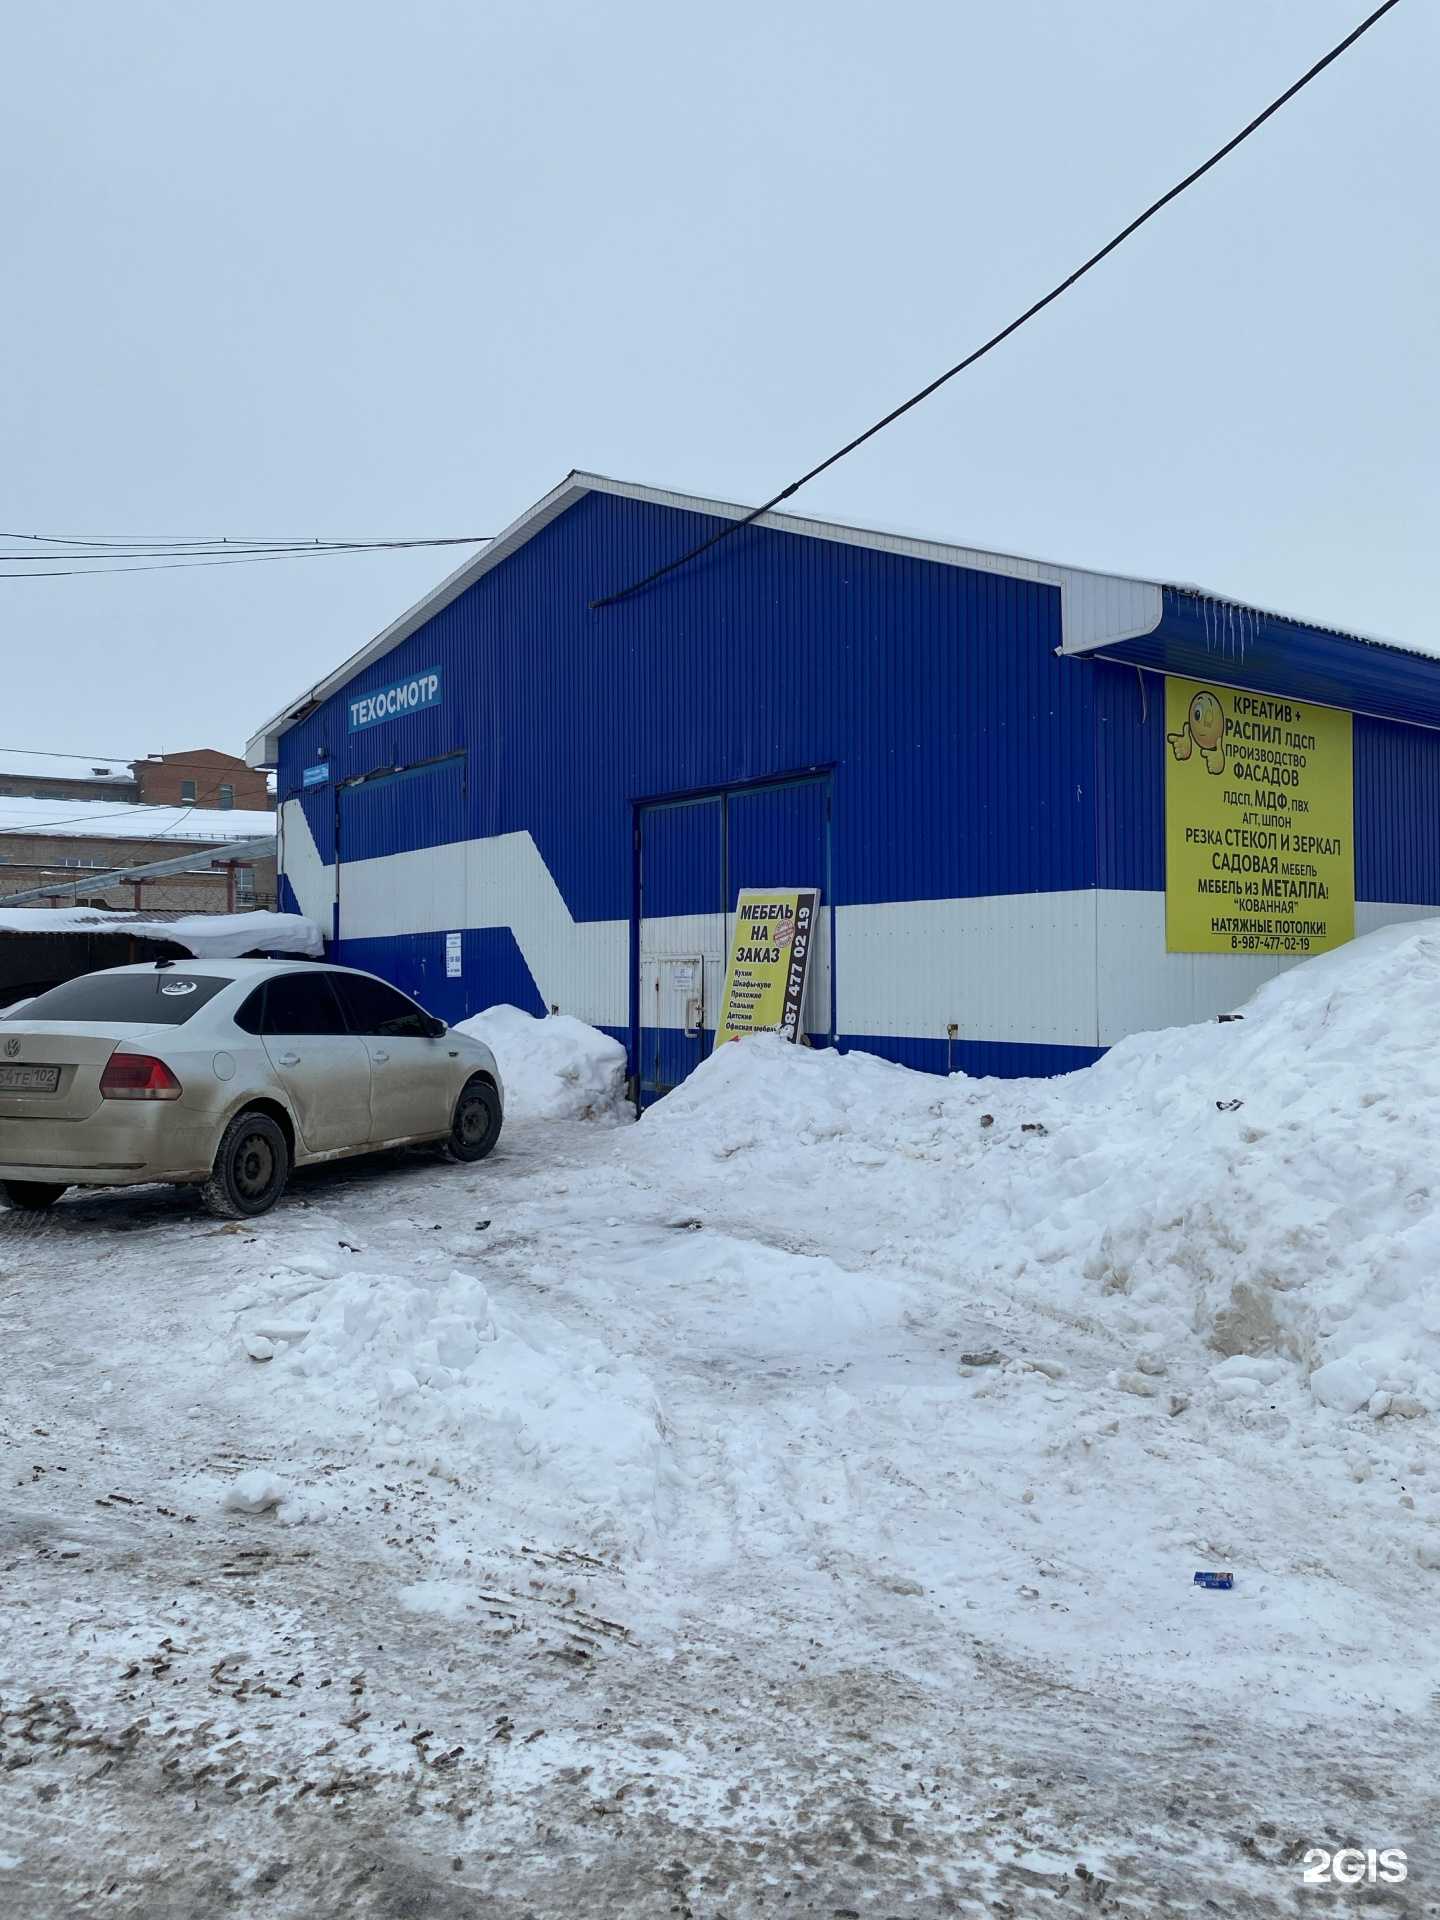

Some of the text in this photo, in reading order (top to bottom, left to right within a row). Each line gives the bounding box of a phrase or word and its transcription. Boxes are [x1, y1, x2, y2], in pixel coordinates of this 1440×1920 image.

[350, 675, 438, 726] ТЕХОСМОТР
[1233, 695, 1292, 723] КРЕАТИВ
[1225, 718, 1315, 750] РАСПИЛ ЛДСП
[1225, 743, 1307, 768] ПРОИЗВОДСТВО
[1233, 762, 1299, 787] ФАСАДОВ
[1291, 799, 1309, 813] ПВХ
[1261, 814, 1292, 829] ШПОН
[1185, 827, 1341, 856] РЕЗКА СТЕКОЛ И ЗЕРКАЛ
[1212, 852, 1318, 877] САДОВАЯ МЕБЕЛЬ
[1198, 878, 1329, 900] МЕБЕЛЬ ИЗ МЕТАЛЛА!
[740, 904, 794, 921] МЕБЕЛЬ
[797, 907, 811, 930] 19
[750, 925, 768, 941] НА
[1211, 917, 1327, 935] НАТЯЖНЫЕ ПОТОЛКИ!
[793, 934, 807, 959] 02
[1231, 935, 1310, 950] 8-987-477-02-19
[735, 946, 780, 964] ЗАКАЗ
[732, 979, 772, 990] Шкафы-купе
[734, 969, 753, 978] Кухни
[788, 963, 803, 997] 477
[33, 1069, 54, 1082] 102
